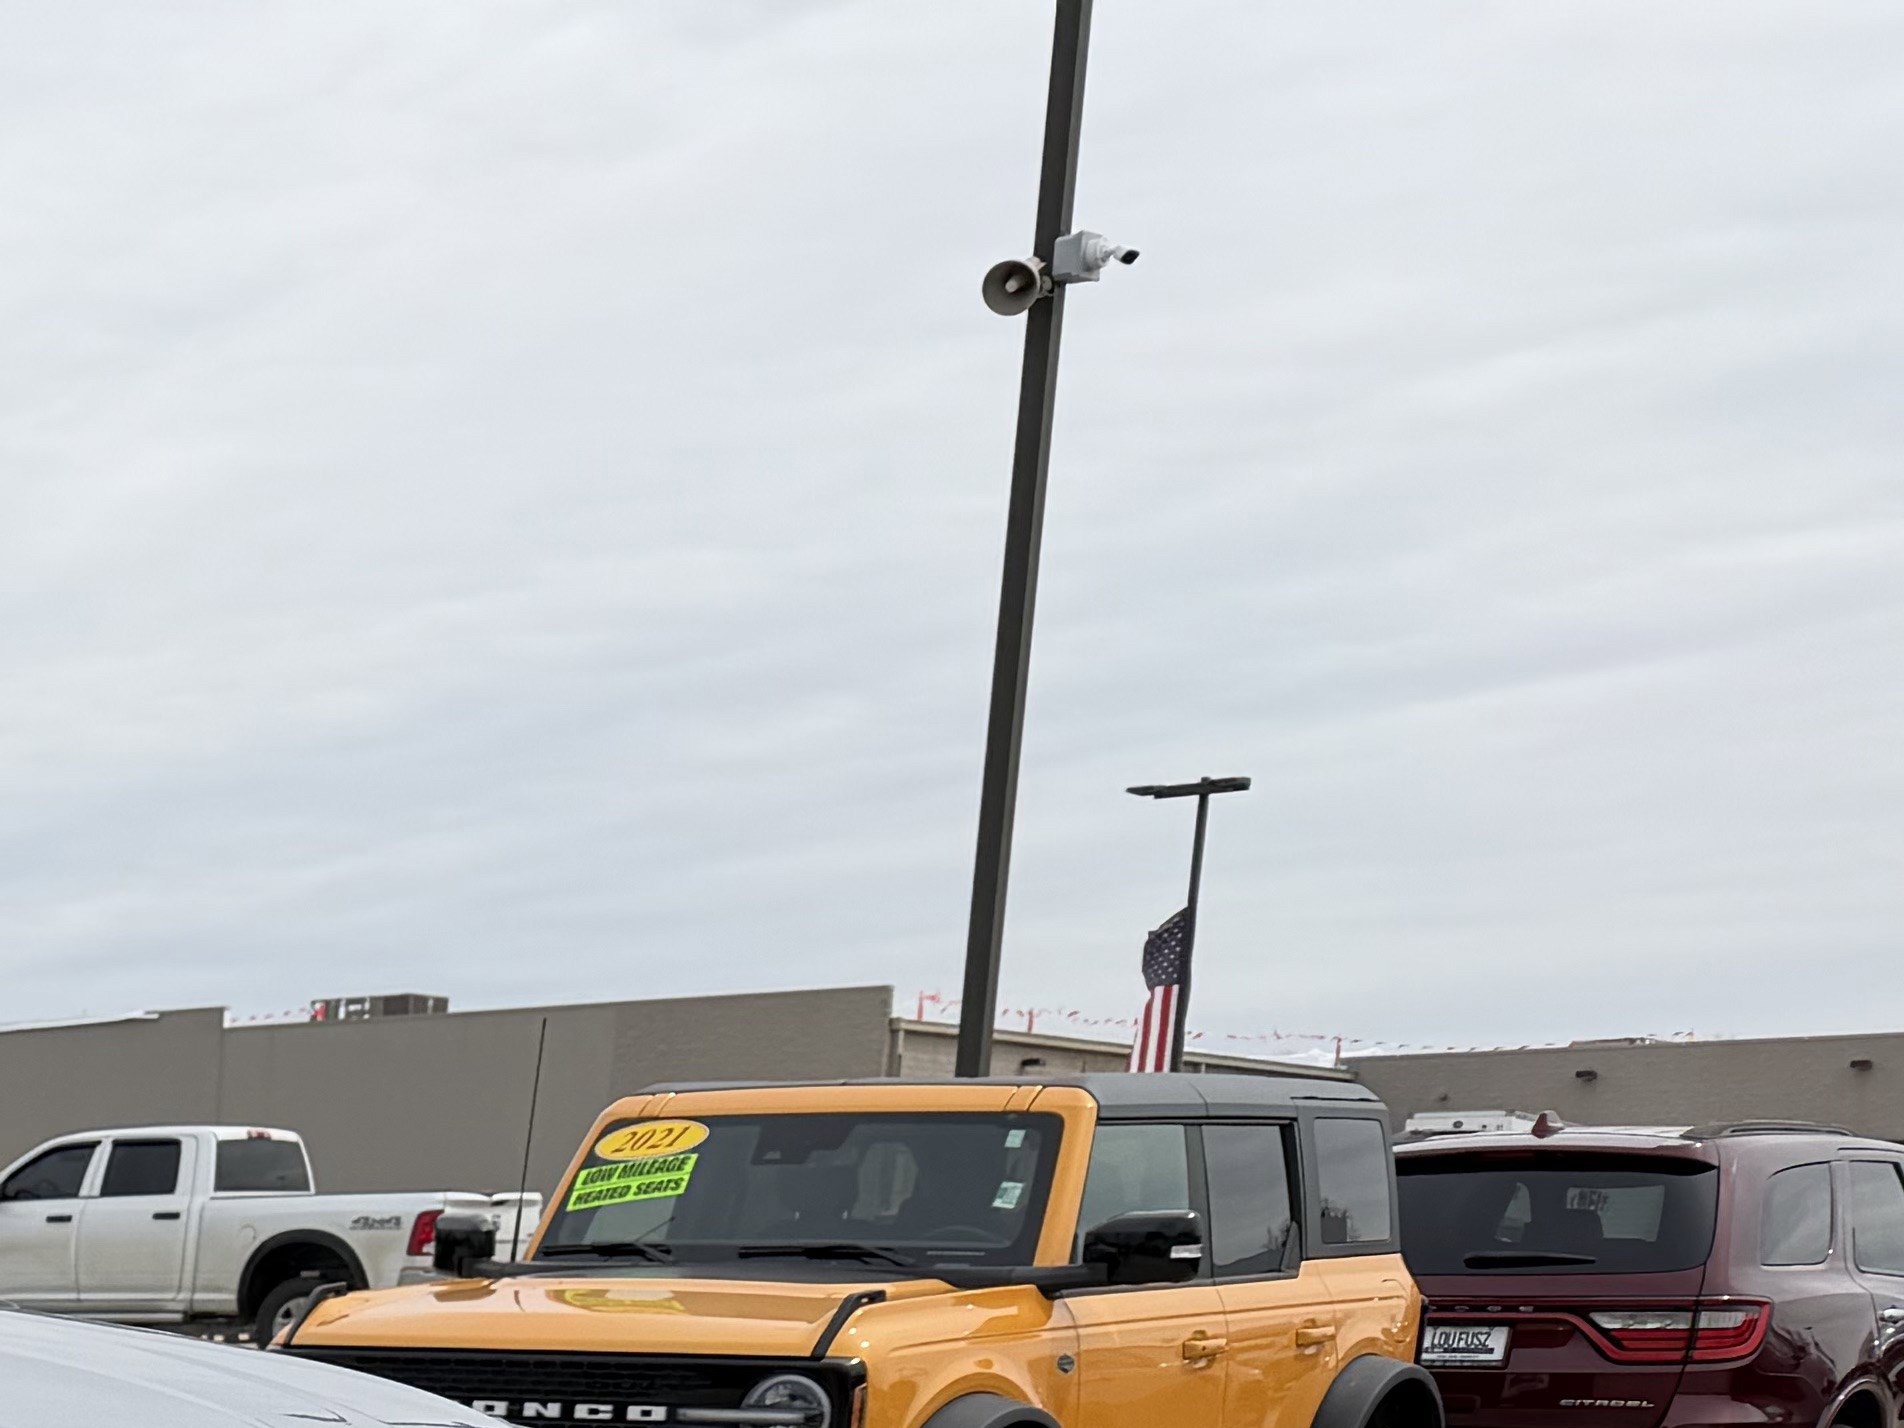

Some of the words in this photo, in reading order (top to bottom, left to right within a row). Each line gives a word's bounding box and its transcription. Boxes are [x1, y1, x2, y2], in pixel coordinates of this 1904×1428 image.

[611, 1125, 691, 1154] 2021
[582, 1164, 619, 1185] LOW
[617, 1154, 692, 1180] MILEAGE
[572, 1184, 632, 1206] HEATED
[632, 1176, 685, 1196] SEATS
[472, 1399, 667, 1422] ONCO
